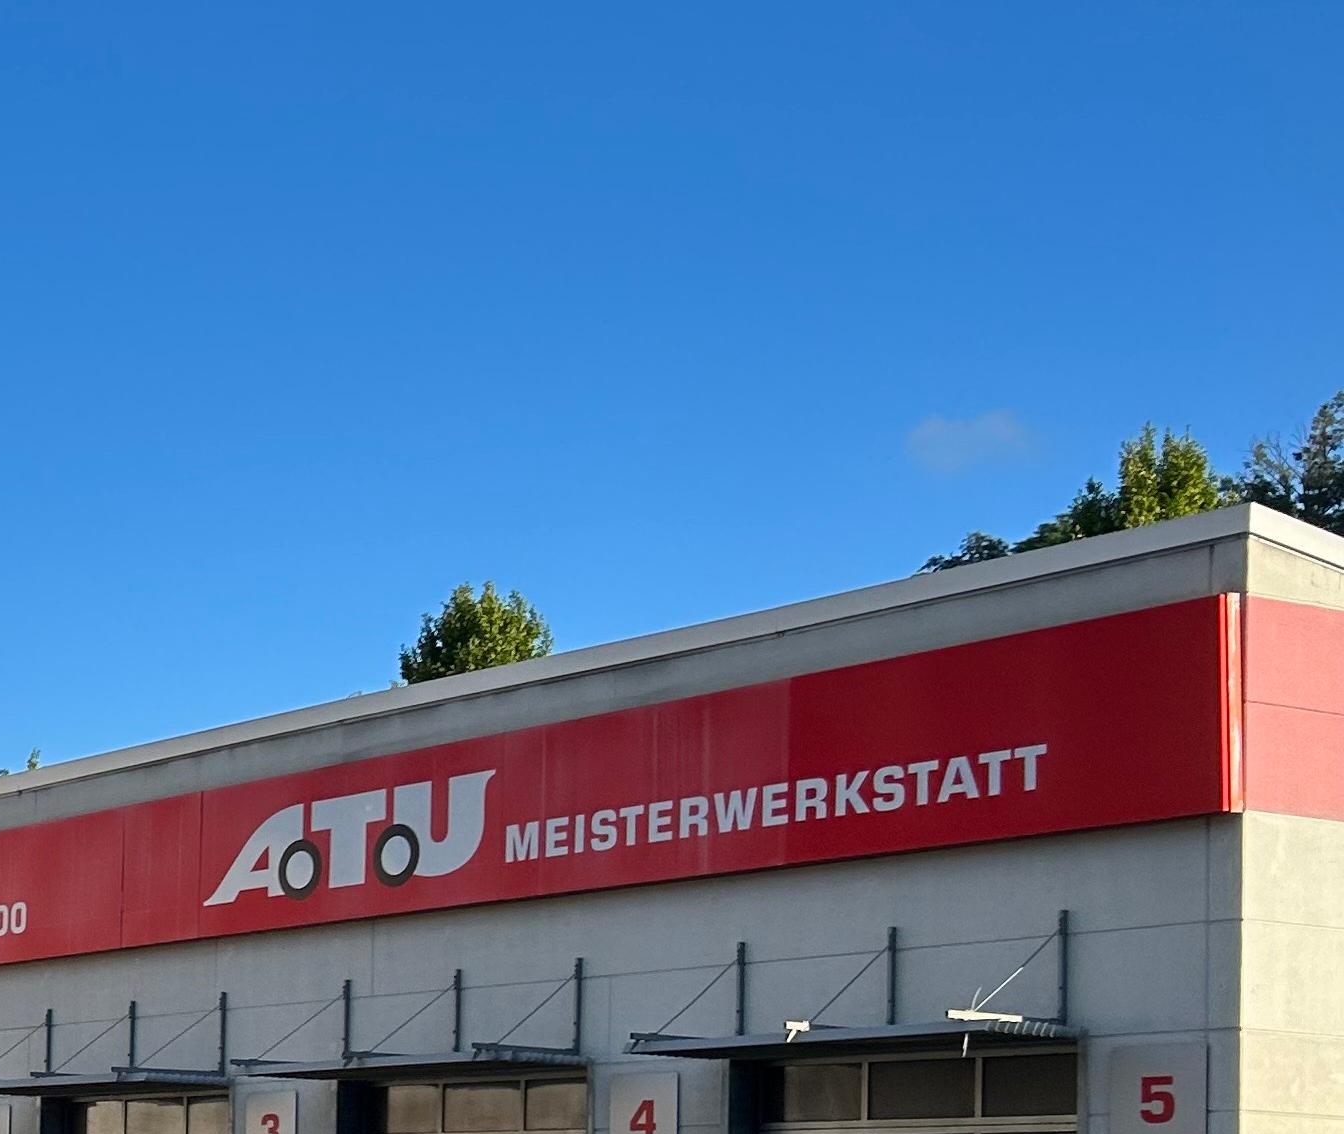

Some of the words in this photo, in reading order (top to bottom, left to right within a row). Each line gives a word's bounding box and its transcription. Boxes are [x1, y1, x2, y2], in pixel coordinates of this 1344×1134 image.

[204, 770, 496, 907] ATU
[506, 744, 1049, 864] MEISTERWERKSTATT
[1140, 1075, 1176, 1124] 5
